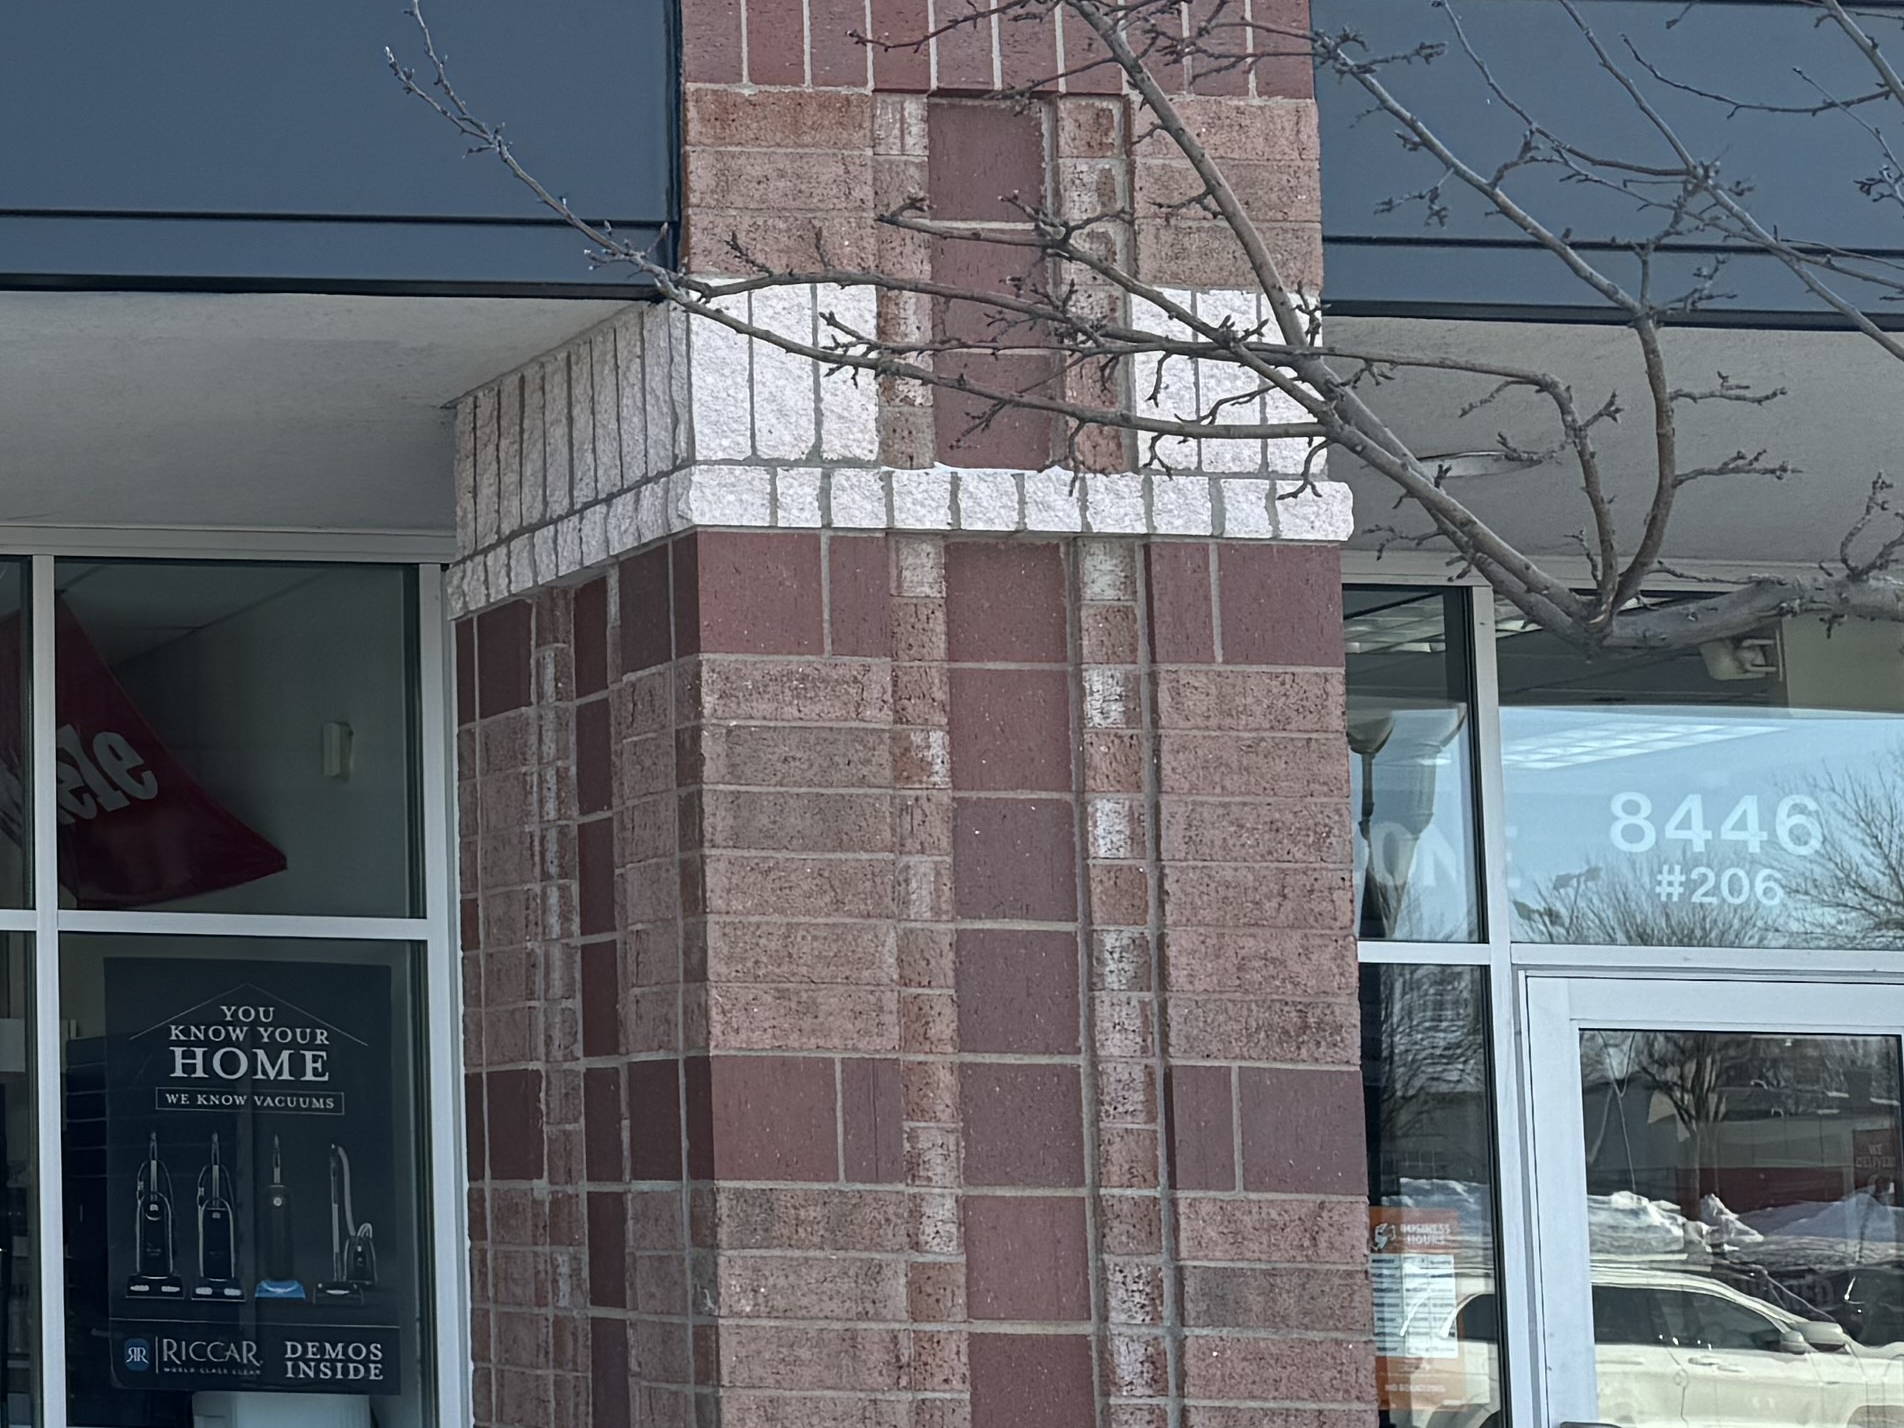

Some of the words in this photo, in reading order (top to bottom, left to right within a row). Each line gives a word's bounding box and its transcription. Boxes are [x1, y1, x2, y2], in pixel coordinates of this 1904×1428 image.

[1609, 792, 1822, 854] 8446
[1655, 864, 1786, 908] #206
[220, 1005, 276, 1022] YOU
[168, 1025, 246, 1042] KNOW
[260, 1027, 332, 1046] YOUR
[169, 1047, 332, 1082] HOME
[165, 1093, 190, 1106] WE
[197, 1094, 248, 1106] KNOW
[254, 1096, 336, 1110] VACUUMS
[162, 1339, 260, 1366] RICCAR
[284, 1341, 384, 1360] DEMOS
[284, 1361, 384, 1380] INSIDE
